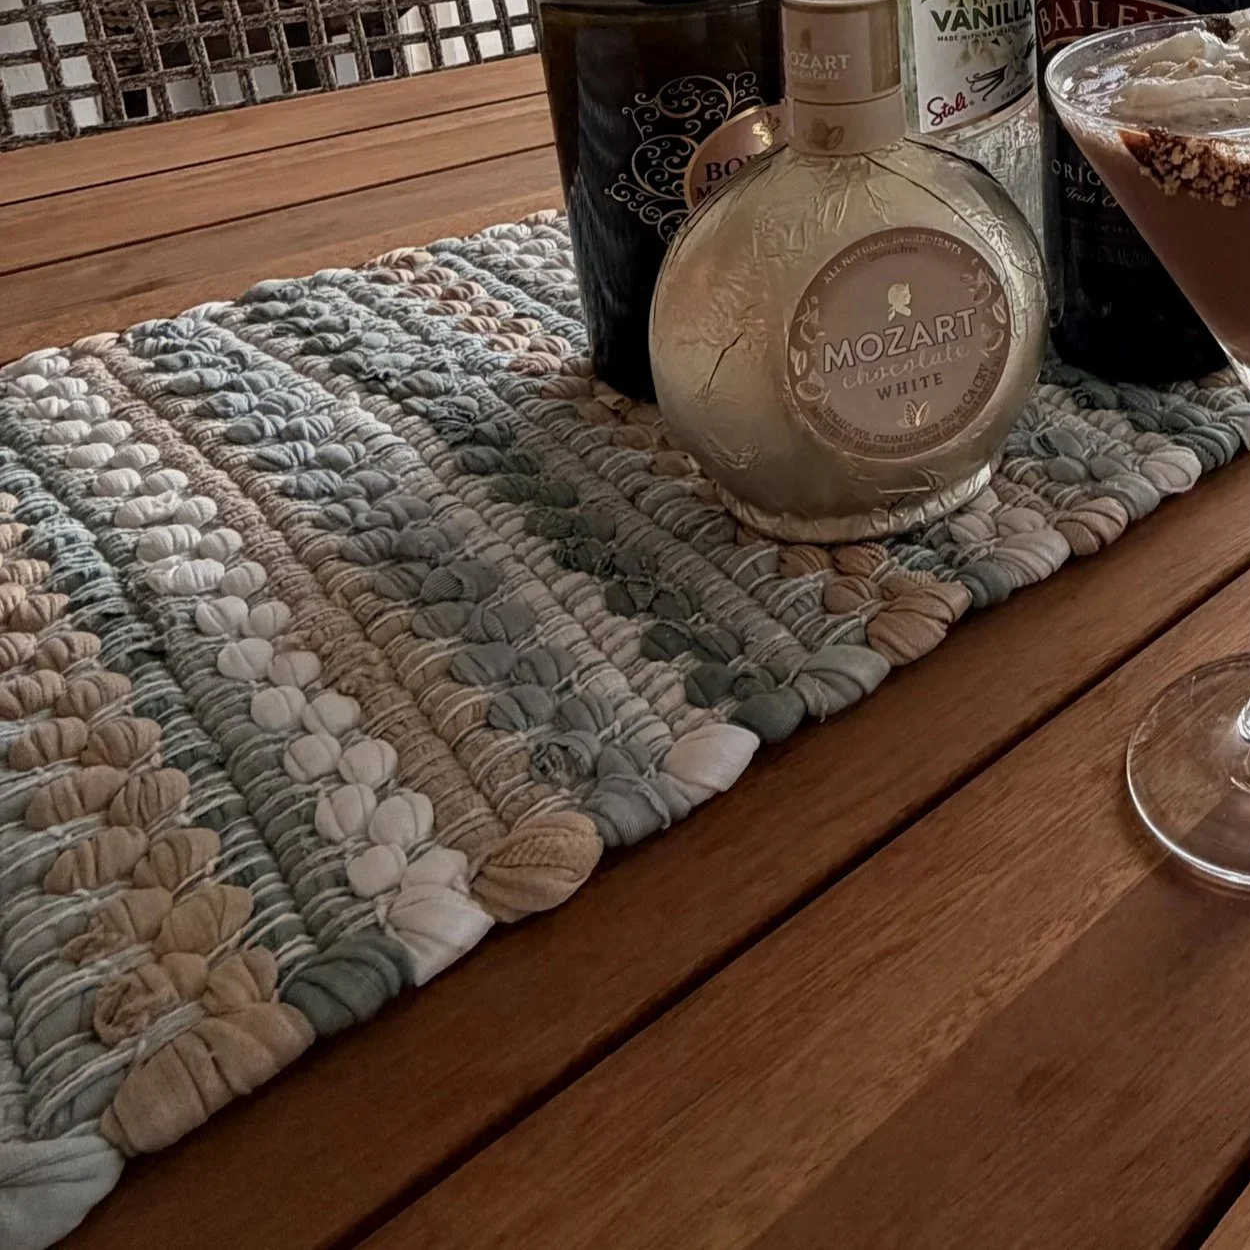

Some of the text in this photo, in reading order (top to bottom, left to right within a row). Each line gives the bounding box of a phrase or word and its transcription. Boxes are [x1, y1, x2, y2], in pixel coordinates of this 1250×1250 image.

[824, 264, 841, 284] ALL
[823, 307, 976, 374] MOZART
[842, 345, 968, 390] chocolate
[876, 372, 943, 400] WHITE
